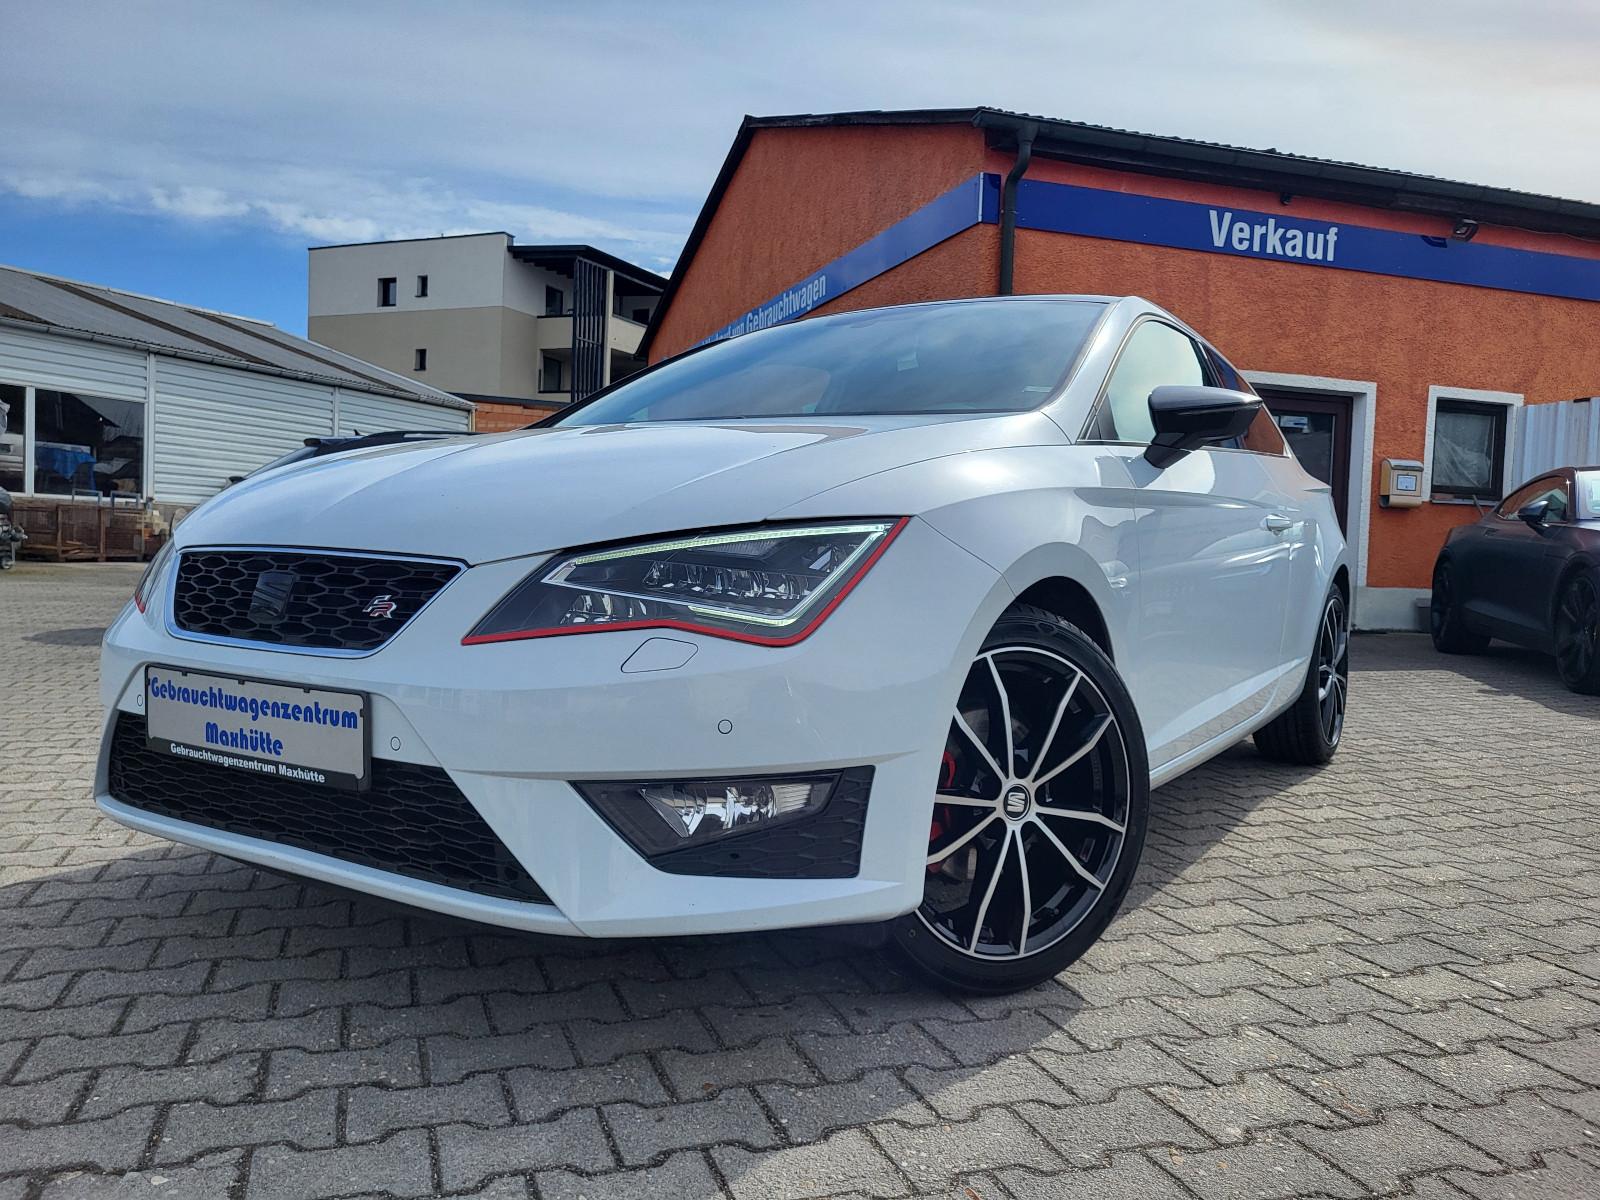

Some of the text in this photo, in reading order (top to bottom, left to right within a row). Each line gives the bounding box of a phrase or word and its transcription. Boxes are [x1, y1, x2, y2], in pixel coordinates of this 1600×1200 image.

[1209, 209, 1338, 262] Verkauf
[746, 275, 826, 334] Gebrauchtwagen
[151, 676, 358, 729] Gebrauchtwagenzentrum
[170, 742, 326, 784] Gebrauchtwagenzentrum Maxhütte
[205, 721, 284, 756] Maxhütte
